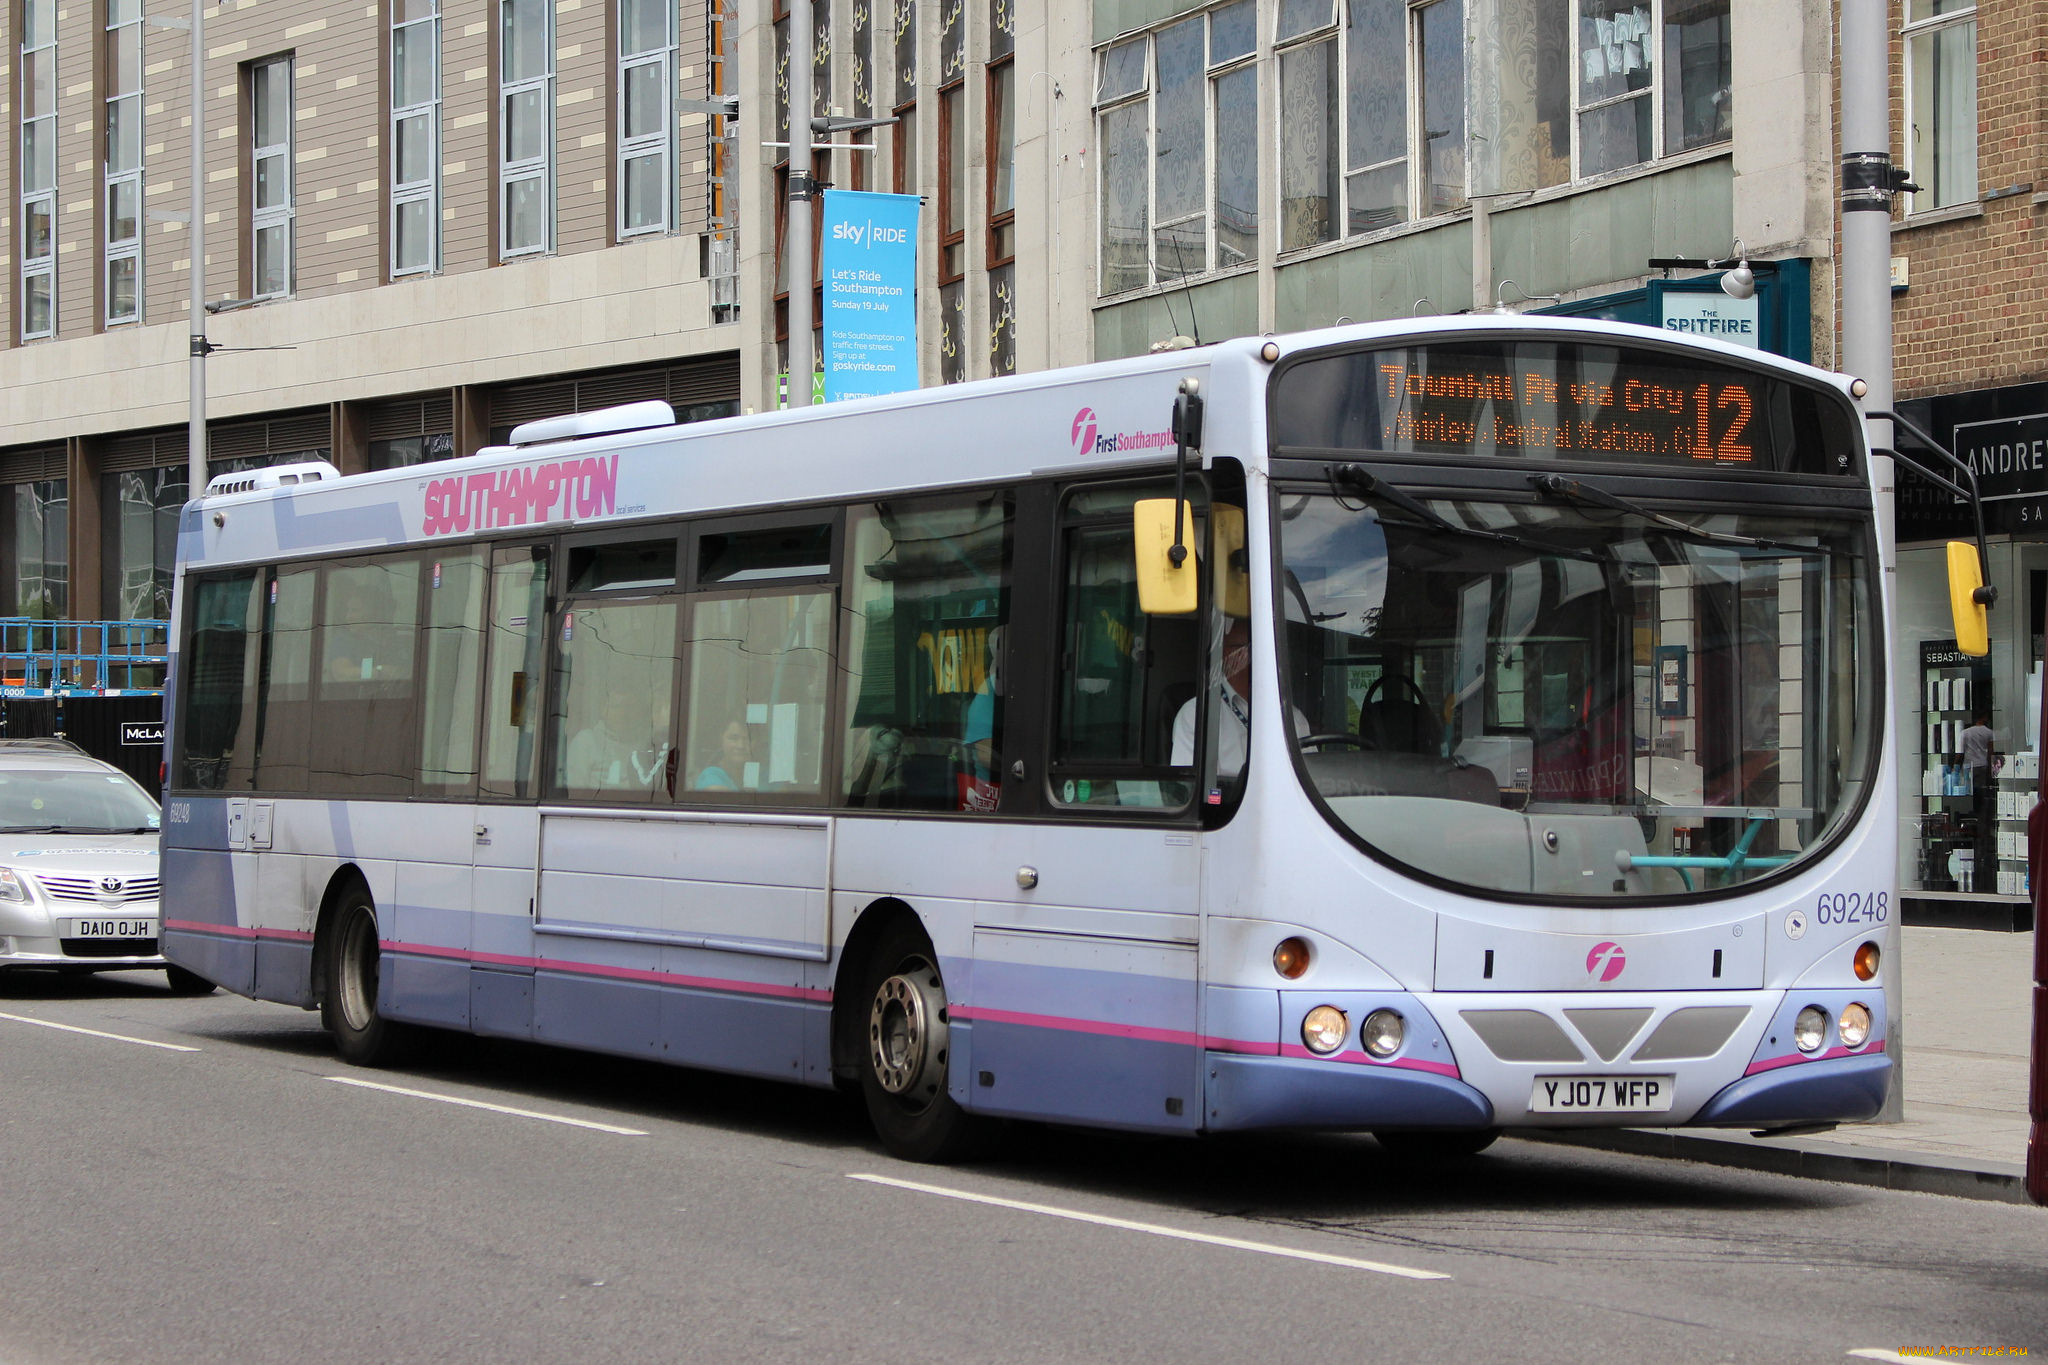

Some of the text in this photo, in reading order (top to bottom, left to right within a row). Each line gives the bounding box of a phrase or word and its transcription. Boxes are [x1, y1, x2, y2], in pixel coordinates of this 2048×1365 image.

[833, 221, 907, 245] sky RIDE
[832, 269, 881, 282] Let's Ride
[831, 281, 903, 297] Southampton
[831, 299, 889, 313] Sunday 19 July
[1666, 318, 1752, 334] SPITFIRE
[832, 330, 847, 339] Ride
[847, 331, 895, 342] Southampton
[832, 341, 895, 352] traffic free streets.
[832, 350, 847, 360] Sign
[832, 361, 896, 373] goskyride.com
[1380, 364, 1683, 414] Townhill Pk via City
[1692, 383, 1752, 462] 12
[1494, 415, 1572, 449] Central
[1967, 439, 2048, 476] ANDRE
[422, 454, 620, 536] SOUTHAMPTON
[126, 728, 165, 739] McLA
[170, 802, 190, 824] 69248
[1817, 891, 1888, 925] 69248
[80, 921, 148, 936] DA10 OJH
[1544, 1081, 1660, 1107] YJ07 WFP
